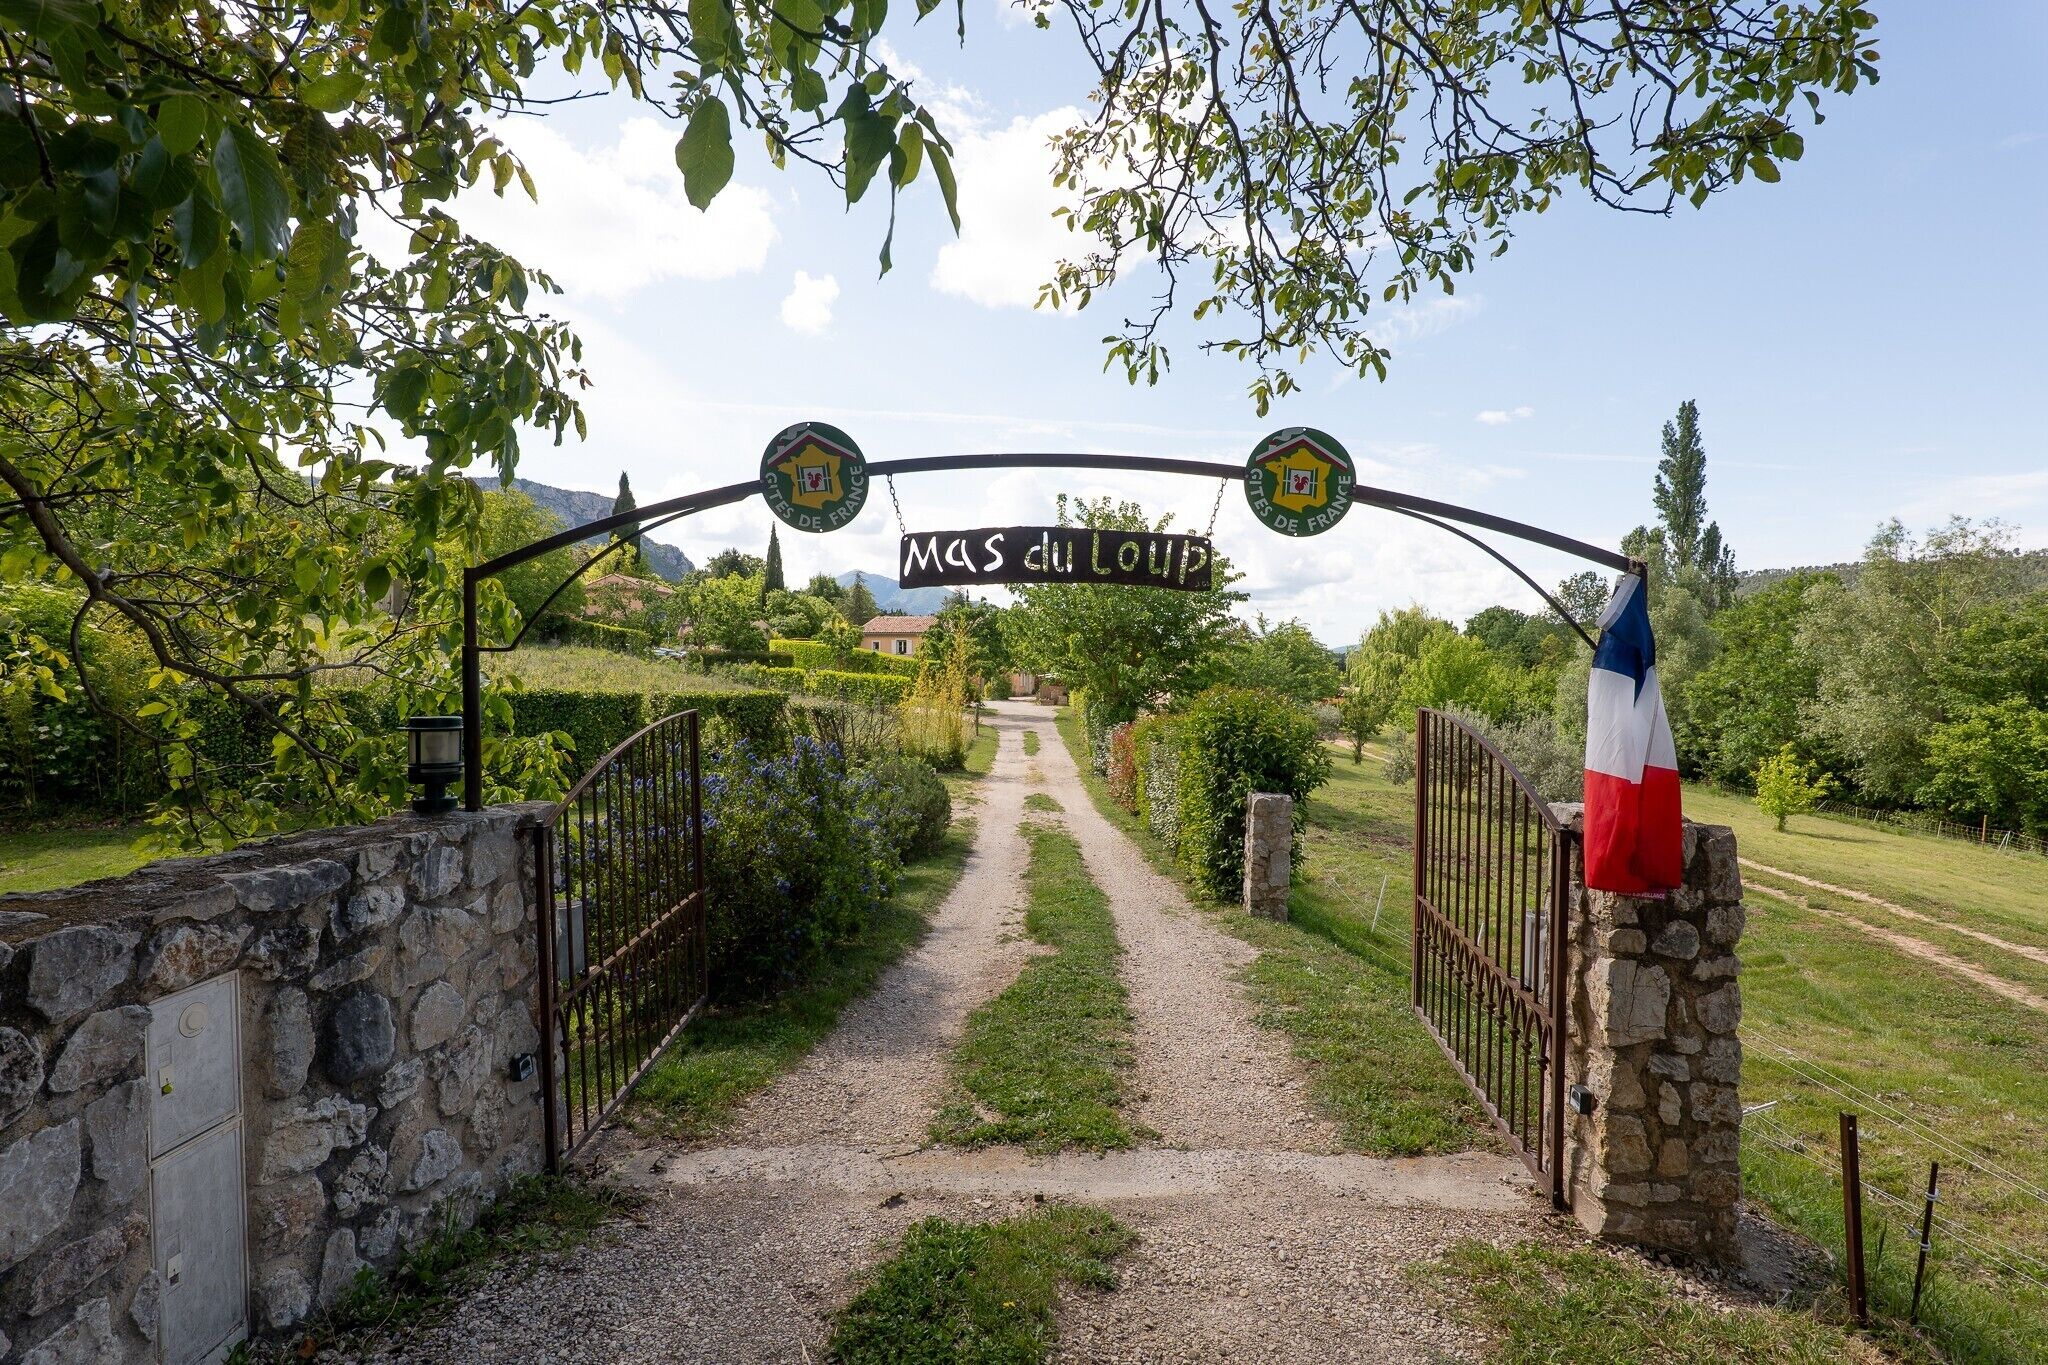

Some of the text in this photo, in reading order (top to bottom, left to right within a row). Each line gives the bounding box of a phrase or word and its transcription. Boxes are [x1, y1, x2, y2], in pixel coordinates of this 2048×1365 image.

[799, 514, 821, 528] DE
[829, 465, 864, 525] FRANCE
[1249, 468, 1351, 532] GITES DE FRANCE
[1024, 531, 1073, 573] du
